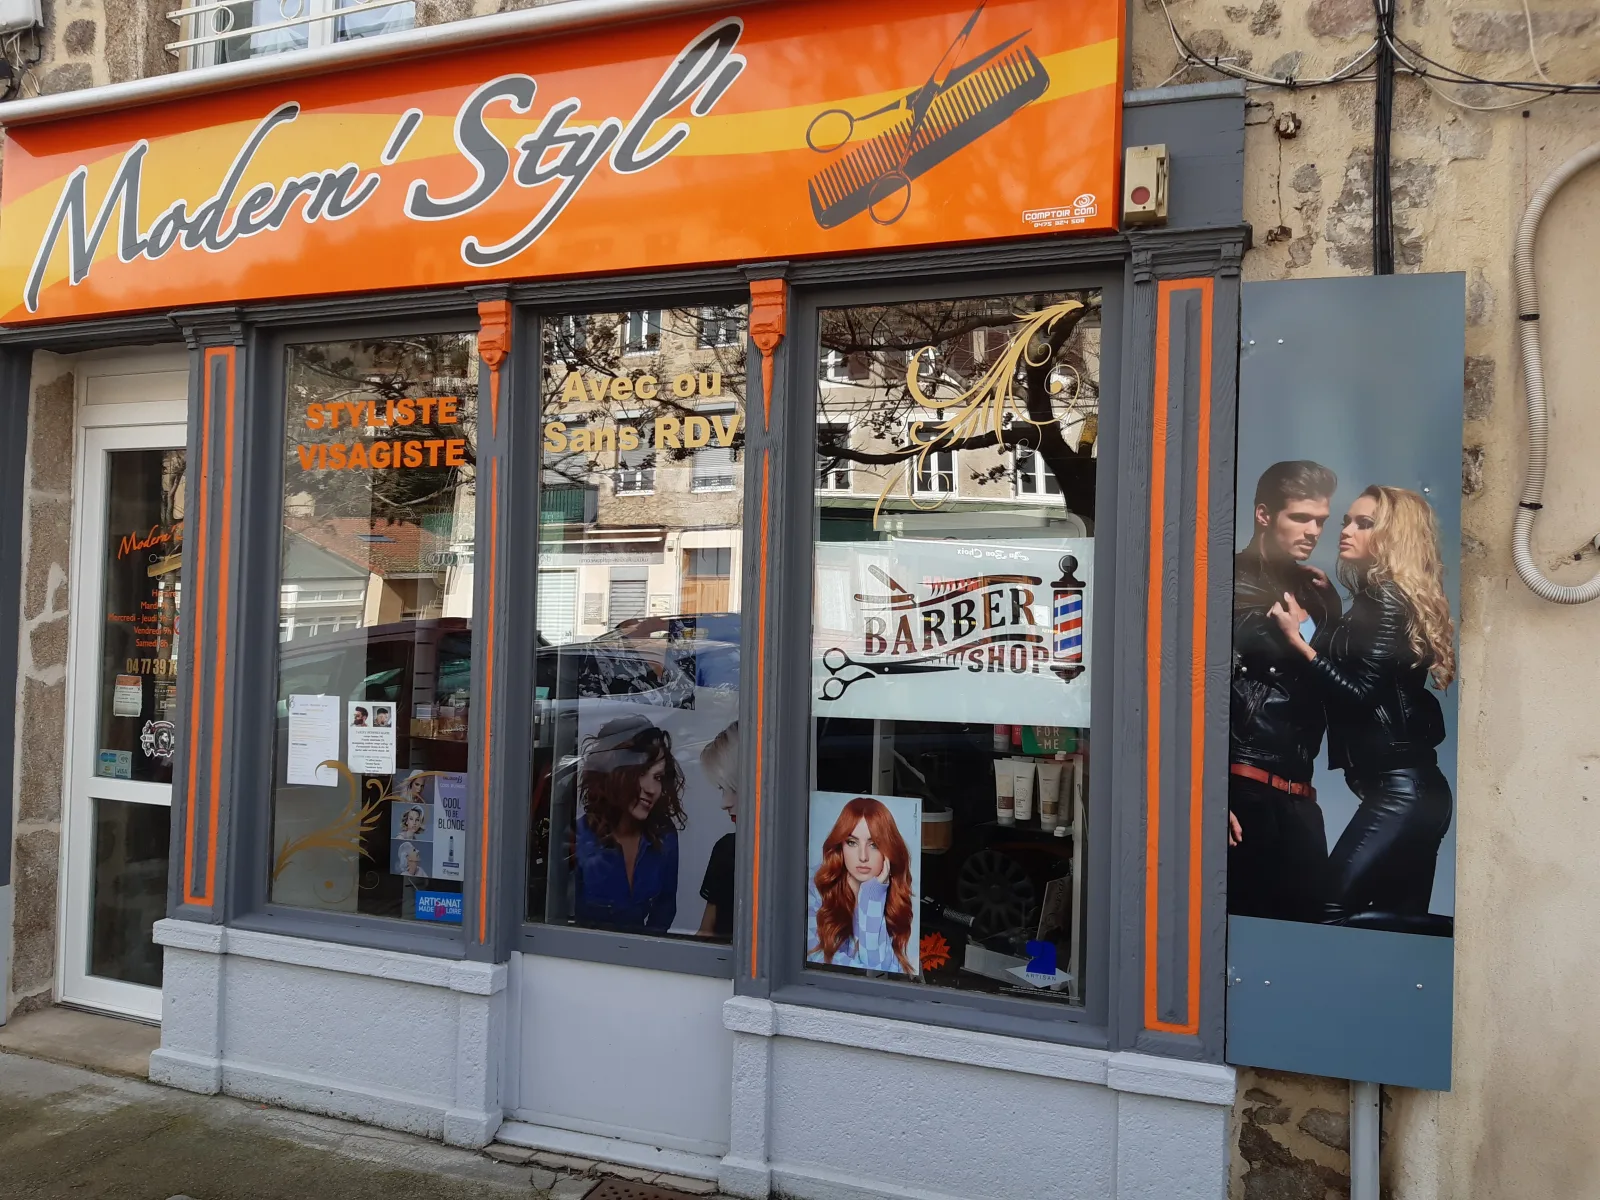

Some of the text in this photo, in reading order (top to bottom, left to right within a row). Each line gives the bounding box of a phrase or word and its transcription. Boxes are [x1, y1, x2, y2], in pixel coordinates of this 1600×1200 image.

[1025, 207, 1095, 221] COMPTOIR COM
[560, 371, 721, 402] Avec ou
[305, 396, 458, 430] STYLISTE
[543, 415, 740, 453] Sans RDV
[297, 438, 466, 471] VISAGISTE
[108, 612, 136, 622] Mercredi
[142, 614, 156, 623] Jeudi
[863, 587, 1035, 656] BARBER
[134, 626, 172, 635] Vendredi 9h
[967, 643, 1050, 674] SHOP
[126, 658, 139, 674] 04
[141, 659, 151, 675] 77
[152, 659, 166, 675] 39
[1036, 726, 1060, 737] FOR
[442, 797, 461, 810] COOL
[445, 809, 459, 819] TO BE
[438, 818, 465, 831] BLONDE
[418, 896, 462, 909] ARTISANAT
[418, 905, 435, 913] MADE
[445, 907, 462, 915] LOIRE
[1025, 972, 1057, 981] ARTISAN
